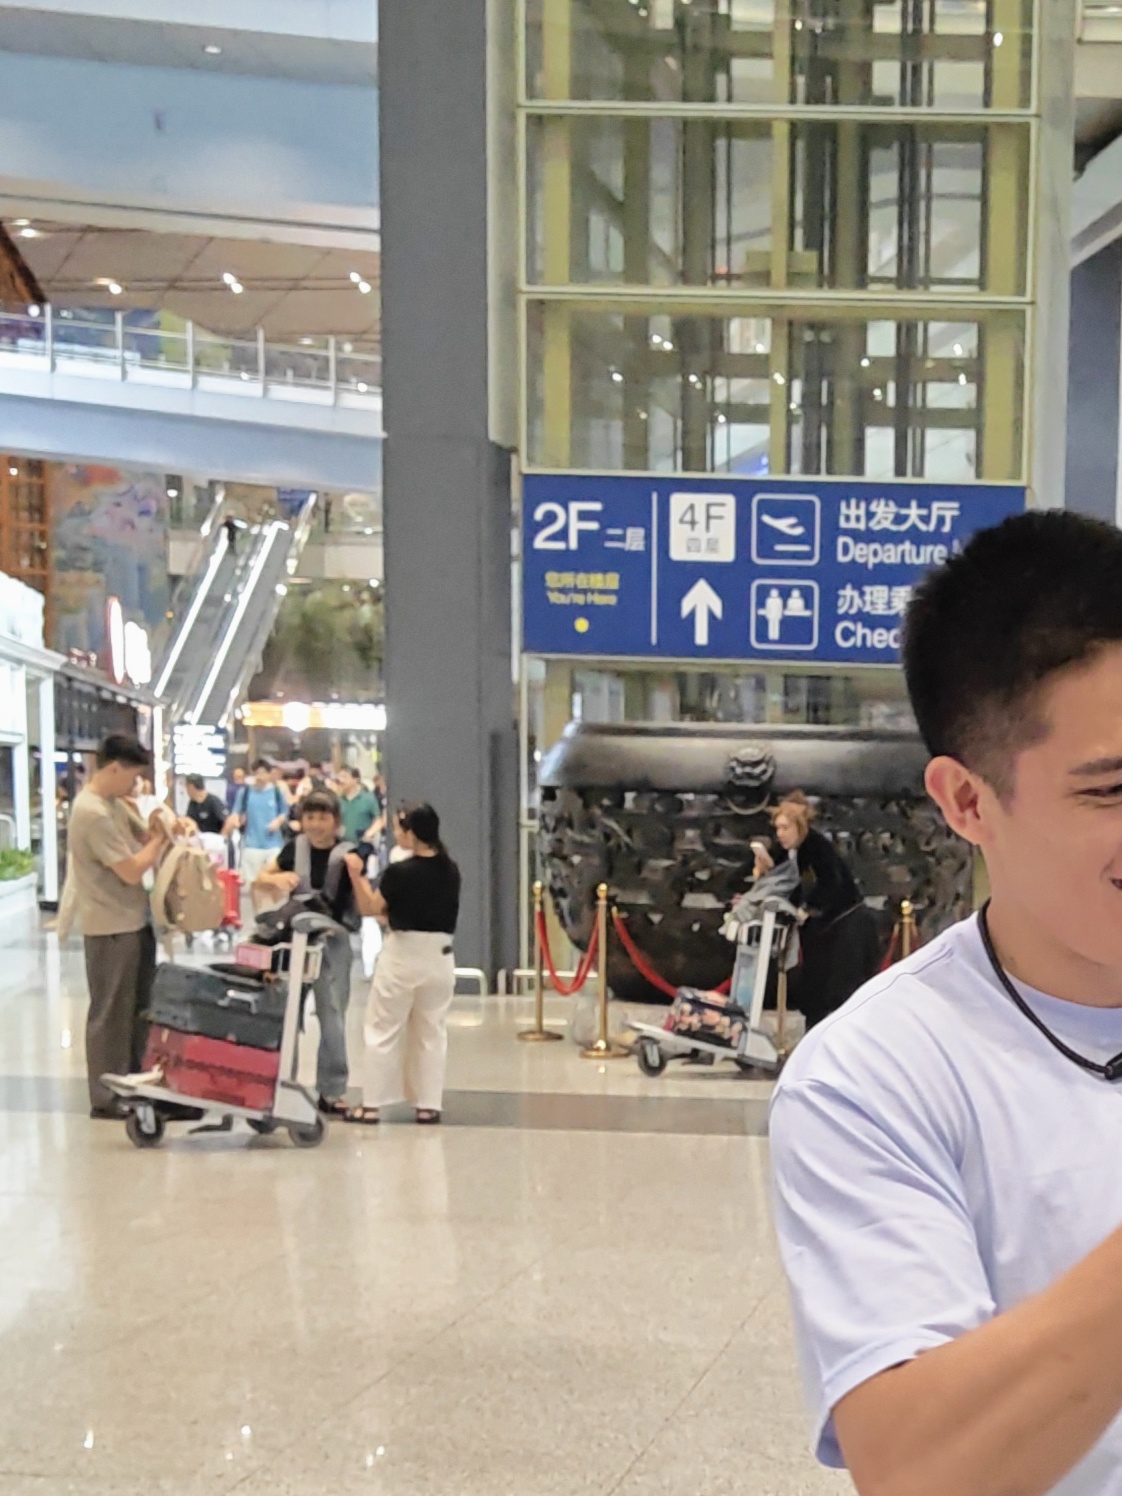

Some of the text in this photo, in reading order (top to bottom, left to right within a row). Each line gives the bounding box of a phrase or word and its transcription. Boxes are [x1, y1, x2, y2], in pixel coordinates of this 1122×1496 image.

[533, 501, 645, 551] 2F 二层
[678, 502, 727, 533] 4F
[838, 497, 961, 533] 出发大厅
[836, 535, 948, 571] Departure
